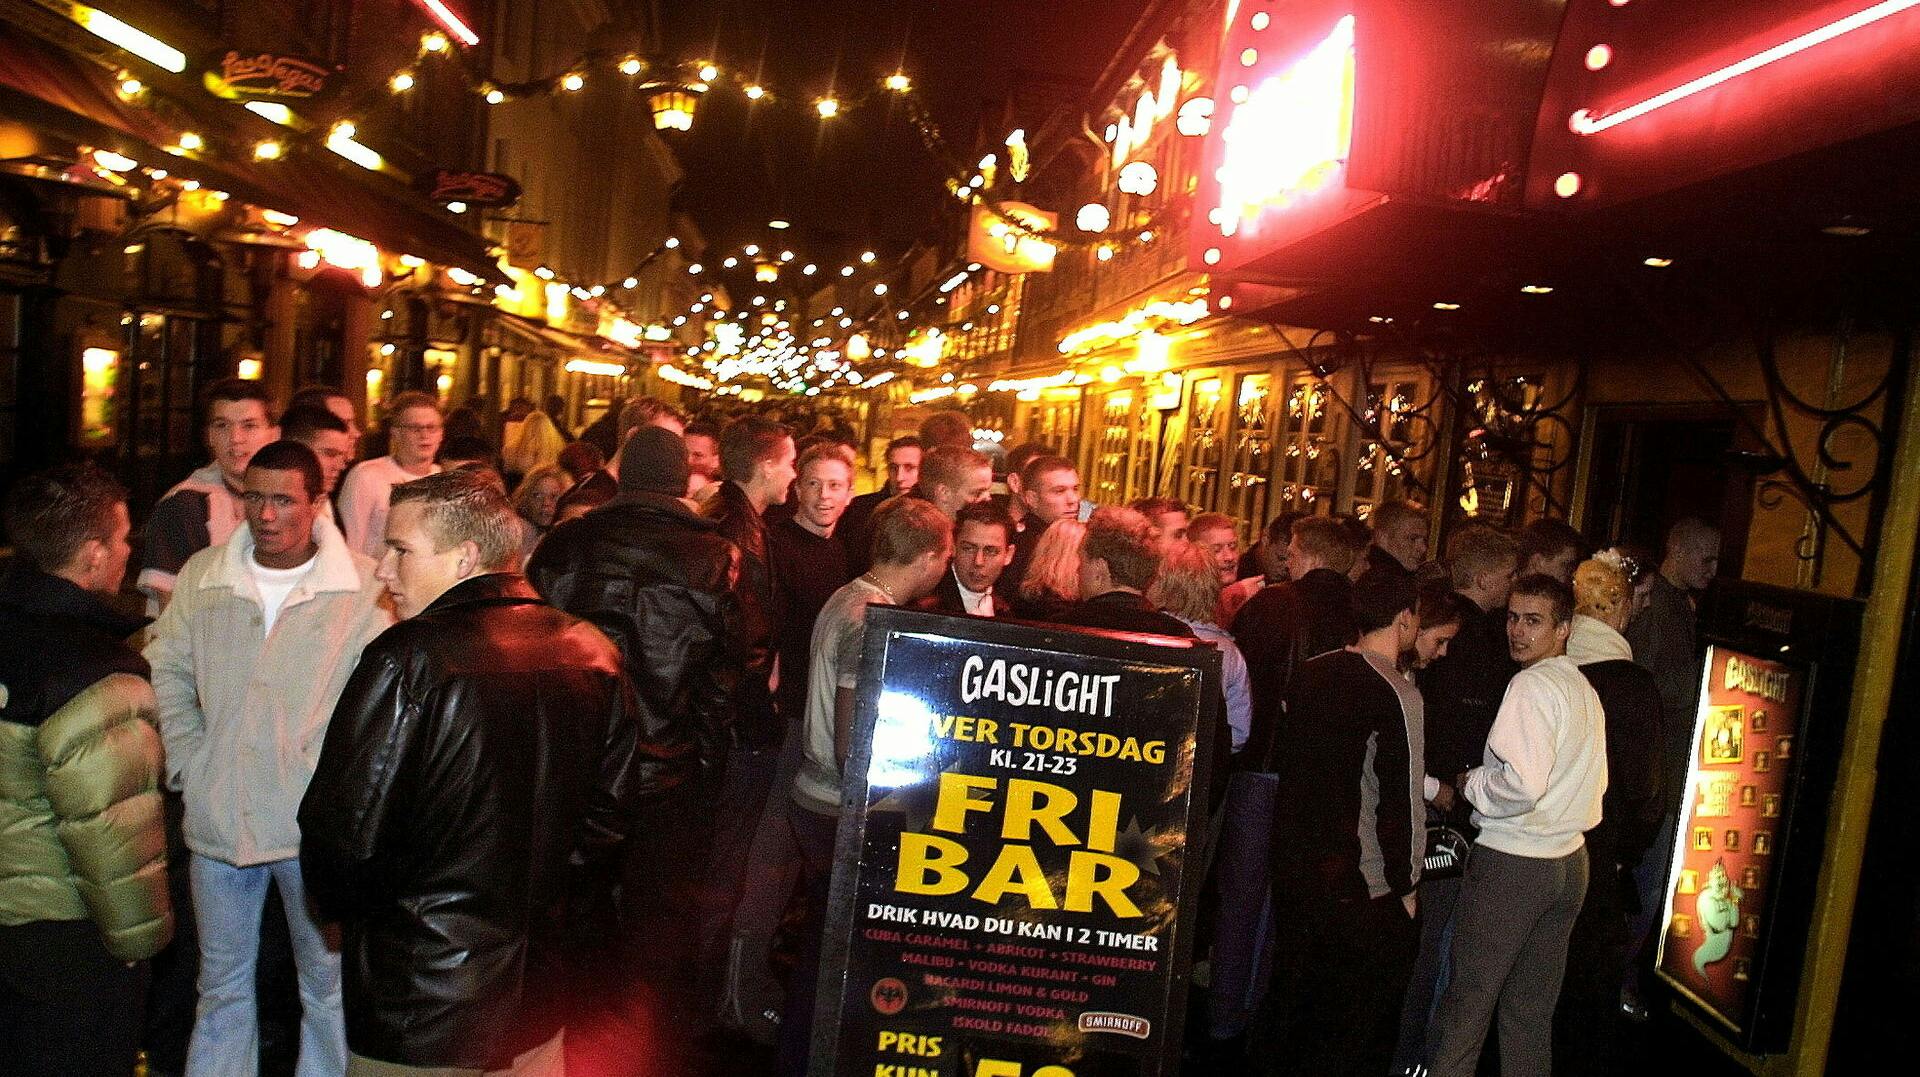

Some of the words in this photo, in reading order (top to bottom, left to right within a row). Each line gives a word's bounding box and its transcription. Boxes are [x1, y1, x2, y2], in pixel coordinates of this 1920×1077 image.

[931, 714, 999, 745] VER
[1008, 722, 1166, 765] TORSDAG
[1022, 752, 1078, 775] 21-23
[932, 772, 1122, 853] FRI
[894, 831, 1144, 918] BAR
[867, 903, 918, 924] DRIK
[921, 910, 980, 931] HVAD
[983, 917, 1014, 936] DU
[1017, 921, 1062, 941] KAN
[1066, 926, 1074, 943] I
[1077, 928, 1091, 945] 2
[1095, 930, 1159, 952] TIMER
[904, 932, 970, 950] CARAMEL
[1061, 952, 1158, 972] STRAWBERRY
[901, 952, 954, 968] MALIBU
[968, 960, 1017, 976] VODKA
[1092, 974, 1117, 987] GIN
[987, 981, 1033, 996] LIMON
[1051, 989, 1089, 1003] GOLD
[943, 996, 1010, 1014] SMIRNOFF
[1016, 1004, 1066, 1020] VODKA
[952, 1016, 1003, 1033] ISKOLD
[1086, 1016, 1143, 1033] SMIRNOFF
[878, 1031, 943, 1057] PRIS
